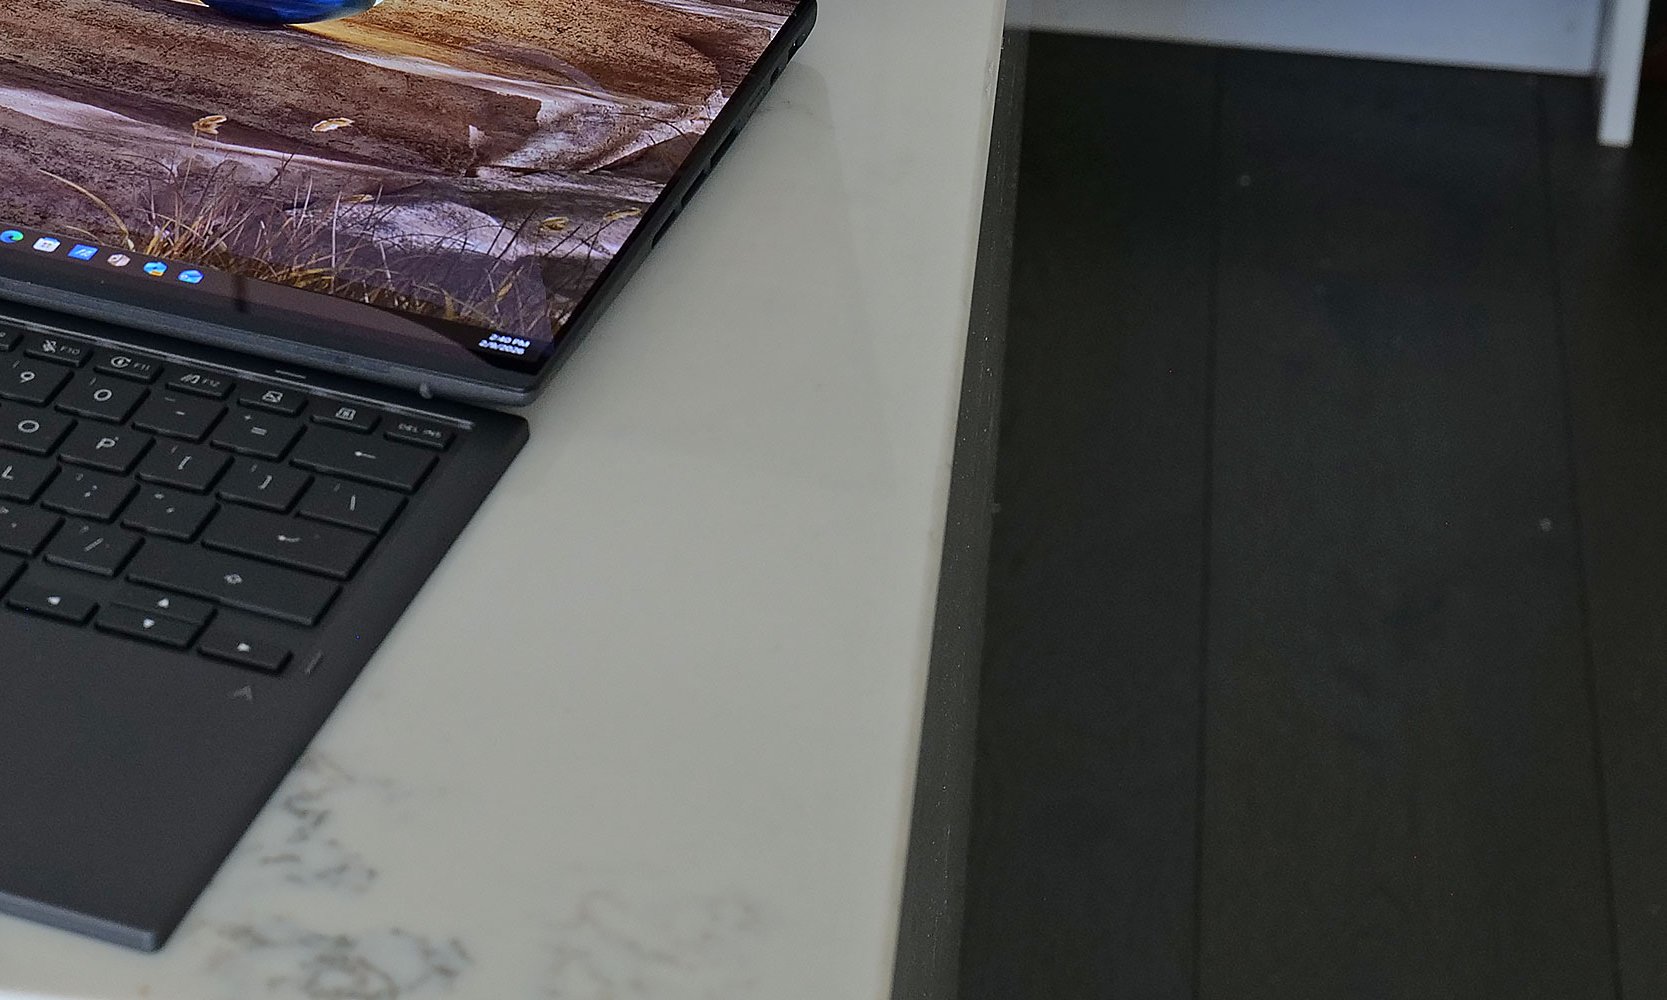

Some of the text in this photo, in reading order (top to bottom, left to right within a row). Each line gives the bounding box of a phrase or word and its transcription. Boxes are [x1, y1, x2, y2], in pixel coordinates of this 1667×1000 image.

[59, 344, 81, 355] F10
[133, 361, 151, 371] F11
[20, 371, 36, 383] 9
[200, 377, 221, 388] F12
[17, 419, 40, 434] O
[95, 437, 117, 450] P
[1, 465, 13, 480] L
